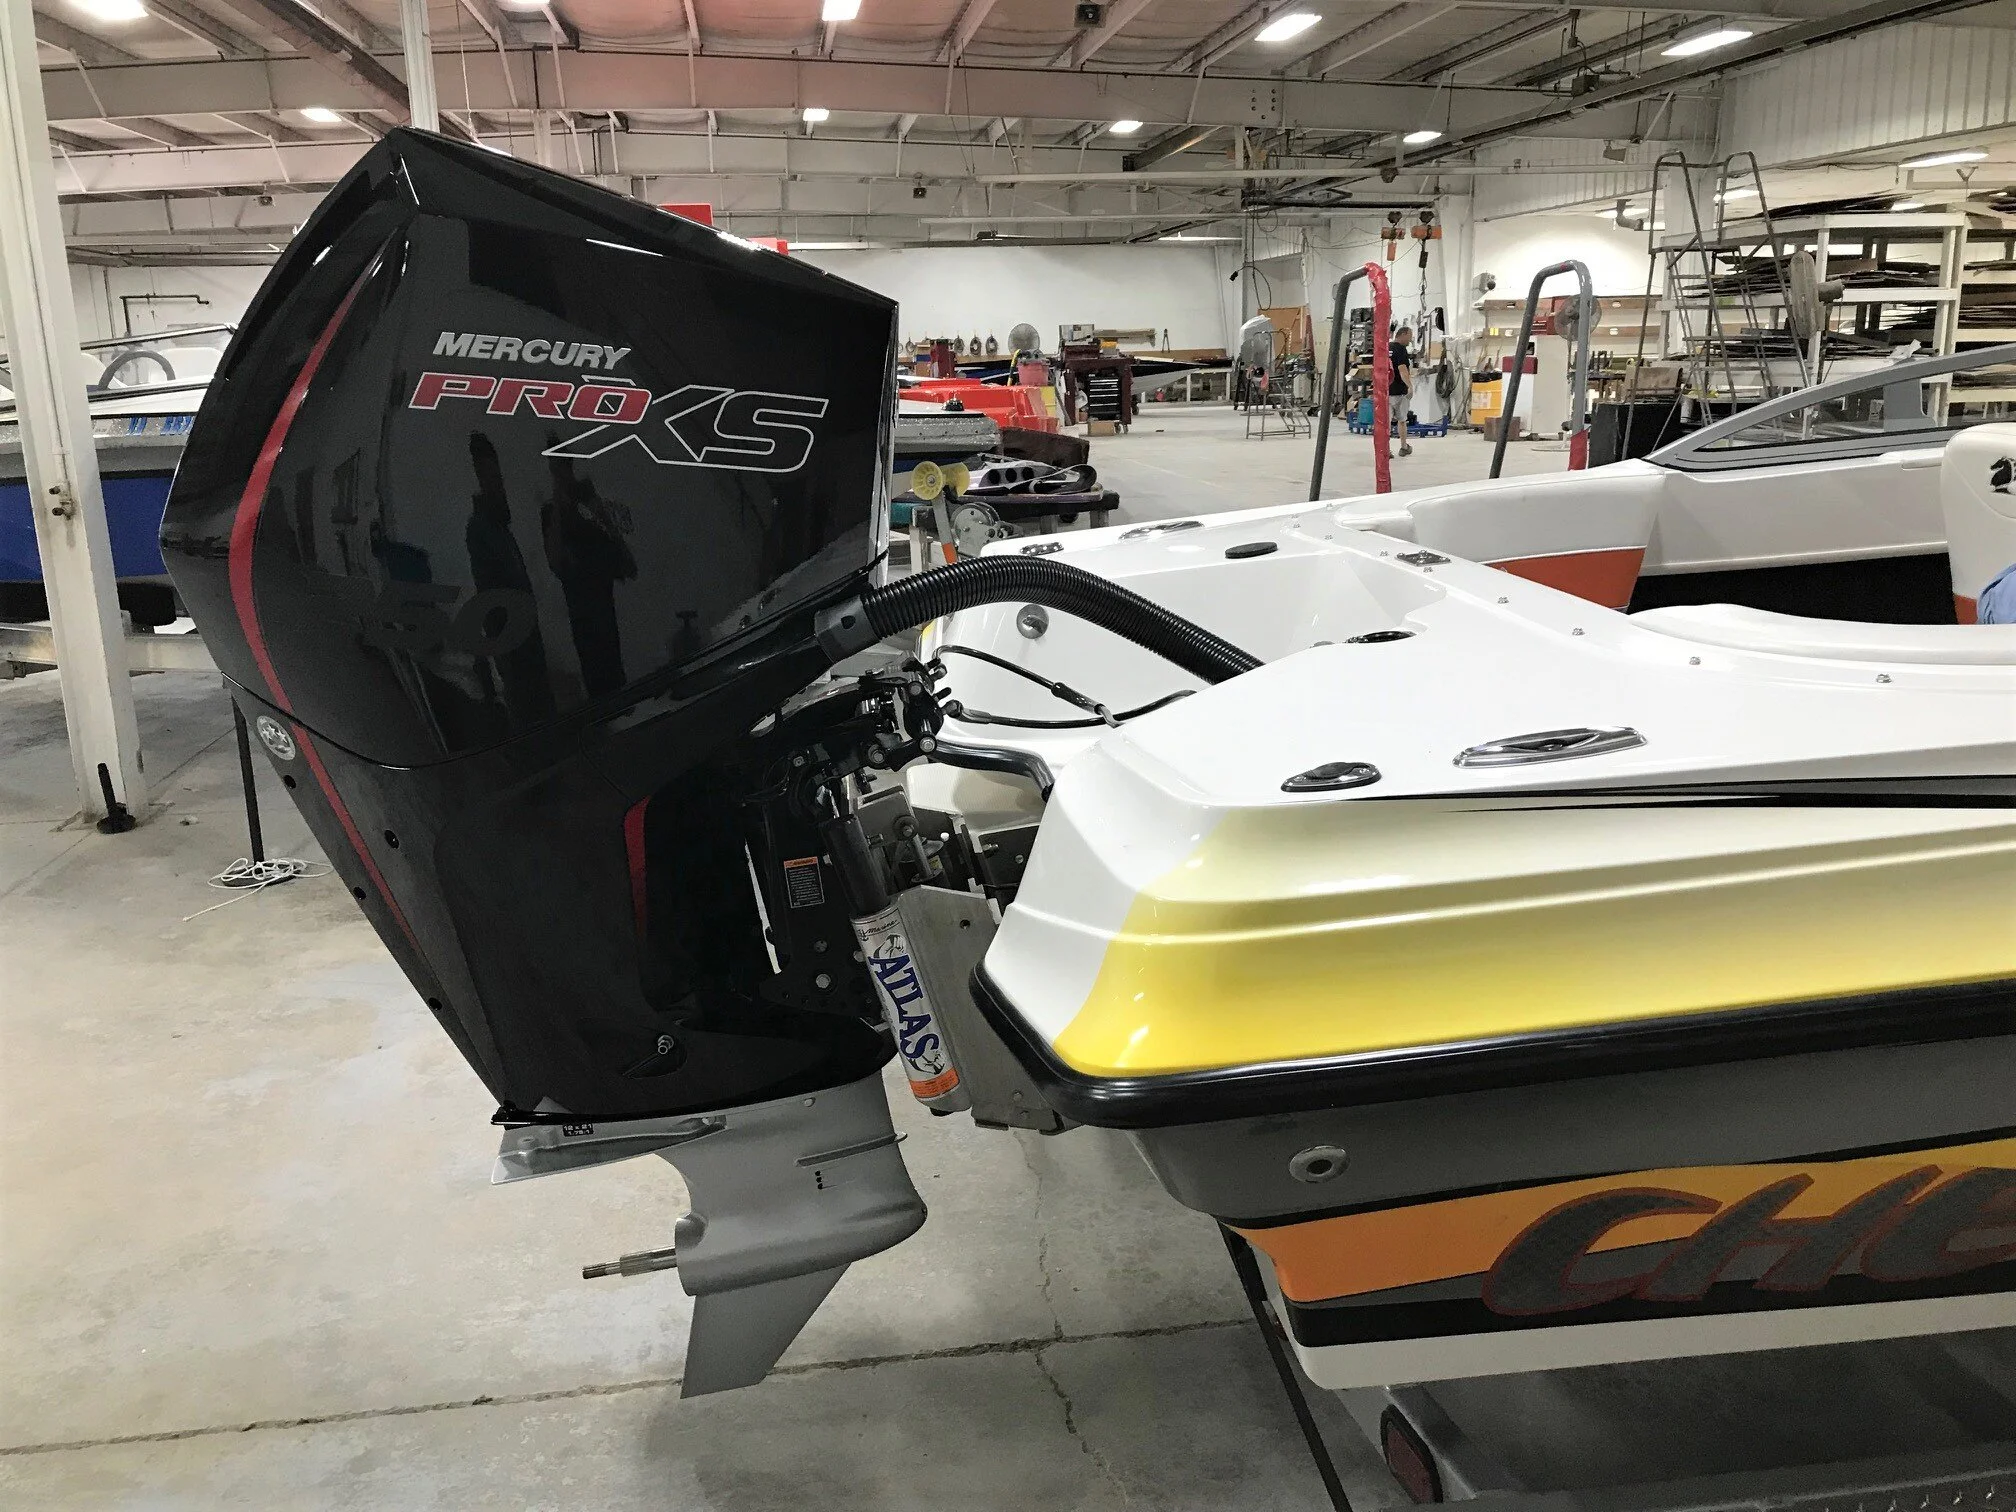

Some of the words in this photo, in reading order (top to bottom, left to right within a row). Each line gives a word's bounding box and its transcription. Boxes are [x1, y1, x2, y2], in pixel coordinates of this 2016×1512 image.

[432, 332, 631, 370] MERCURY
[408, 372, 652, 425] PRO
[868, 954, 940, 1059] ATLAS
